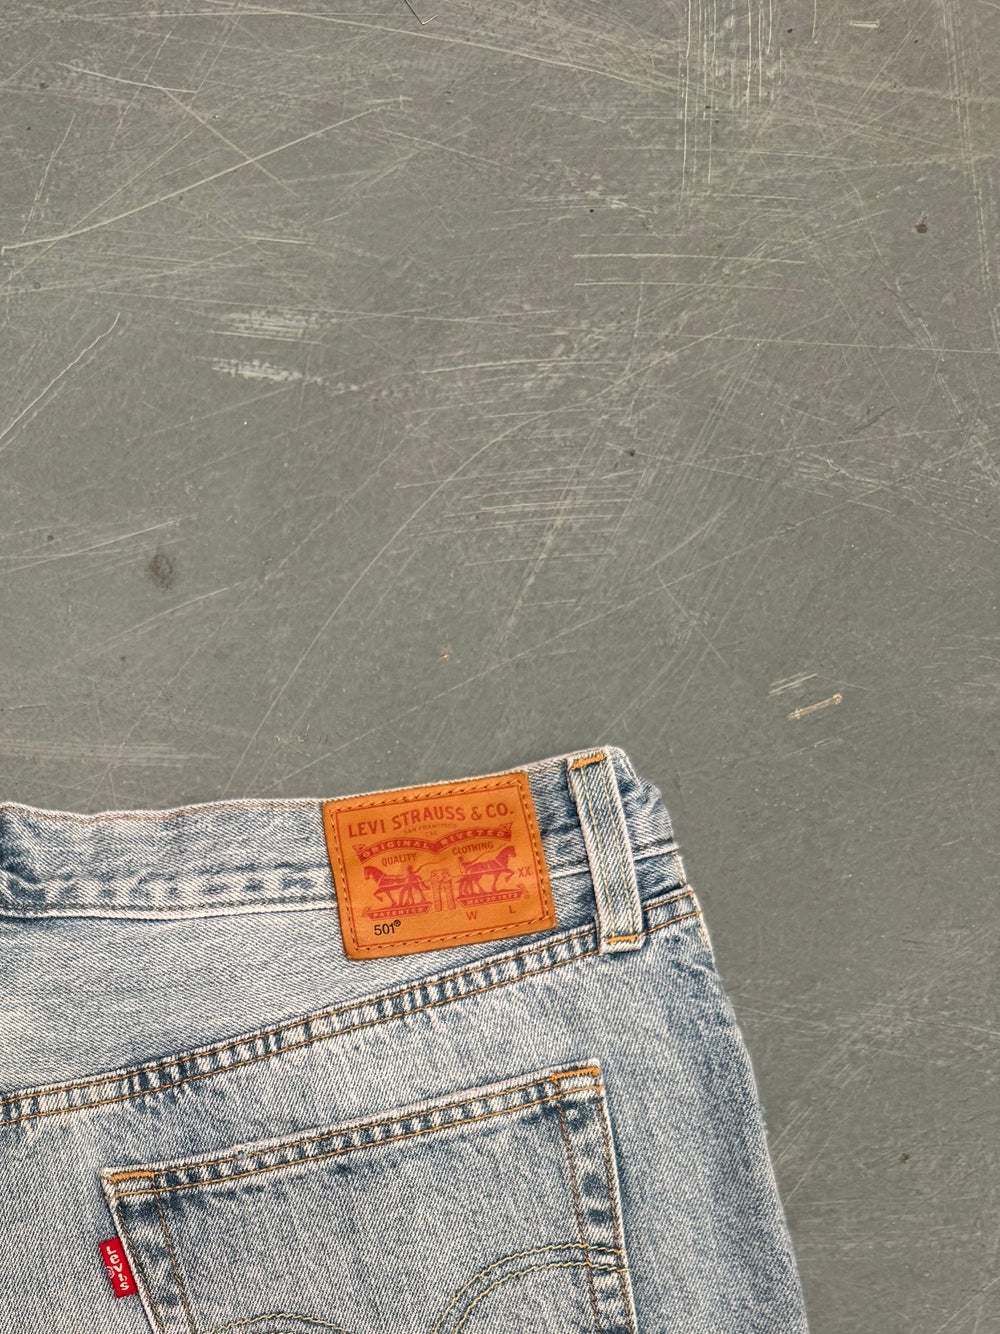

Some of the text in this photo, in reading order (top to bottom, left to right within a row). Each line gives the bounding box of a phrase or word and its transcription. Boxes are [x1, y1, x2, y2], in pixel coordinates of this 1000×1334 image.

[348, 803, 514, 838] LEVI STRAUSS & CO.
[363, 830, 505, 858] ORIGINAL RIVETED
[381, 842, 494, 867] QUALITY CLOTHING
[518, 867, 532, 877] XX
[466, 905, 516, 920] W L
